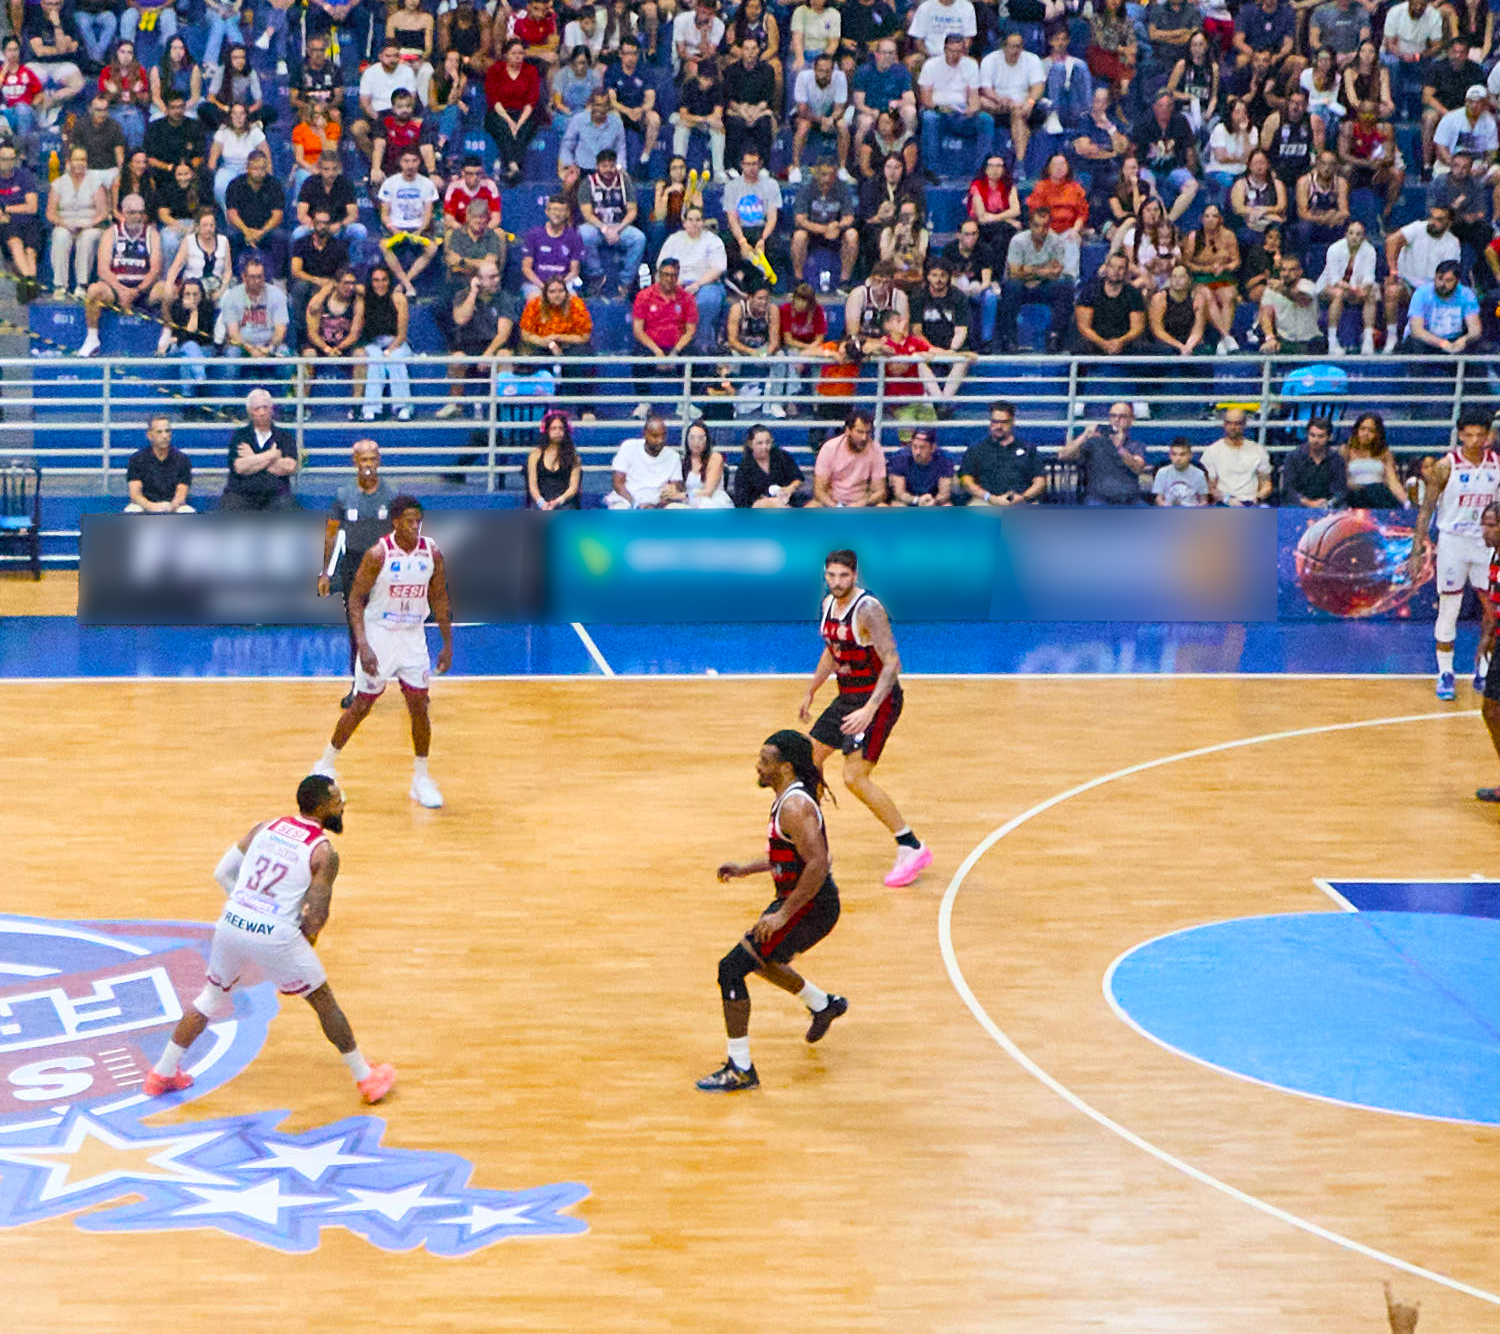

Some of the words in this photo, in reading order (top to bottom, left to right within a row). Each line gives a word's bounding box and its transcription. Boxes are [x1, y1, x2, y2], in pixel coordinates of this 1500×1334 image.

[391, 586, 424, 598] SESI
[277, 824, 306, 839] SESI
[246, 855, 289, 899] 32
[224, 911, 275, 935] REEWAY
